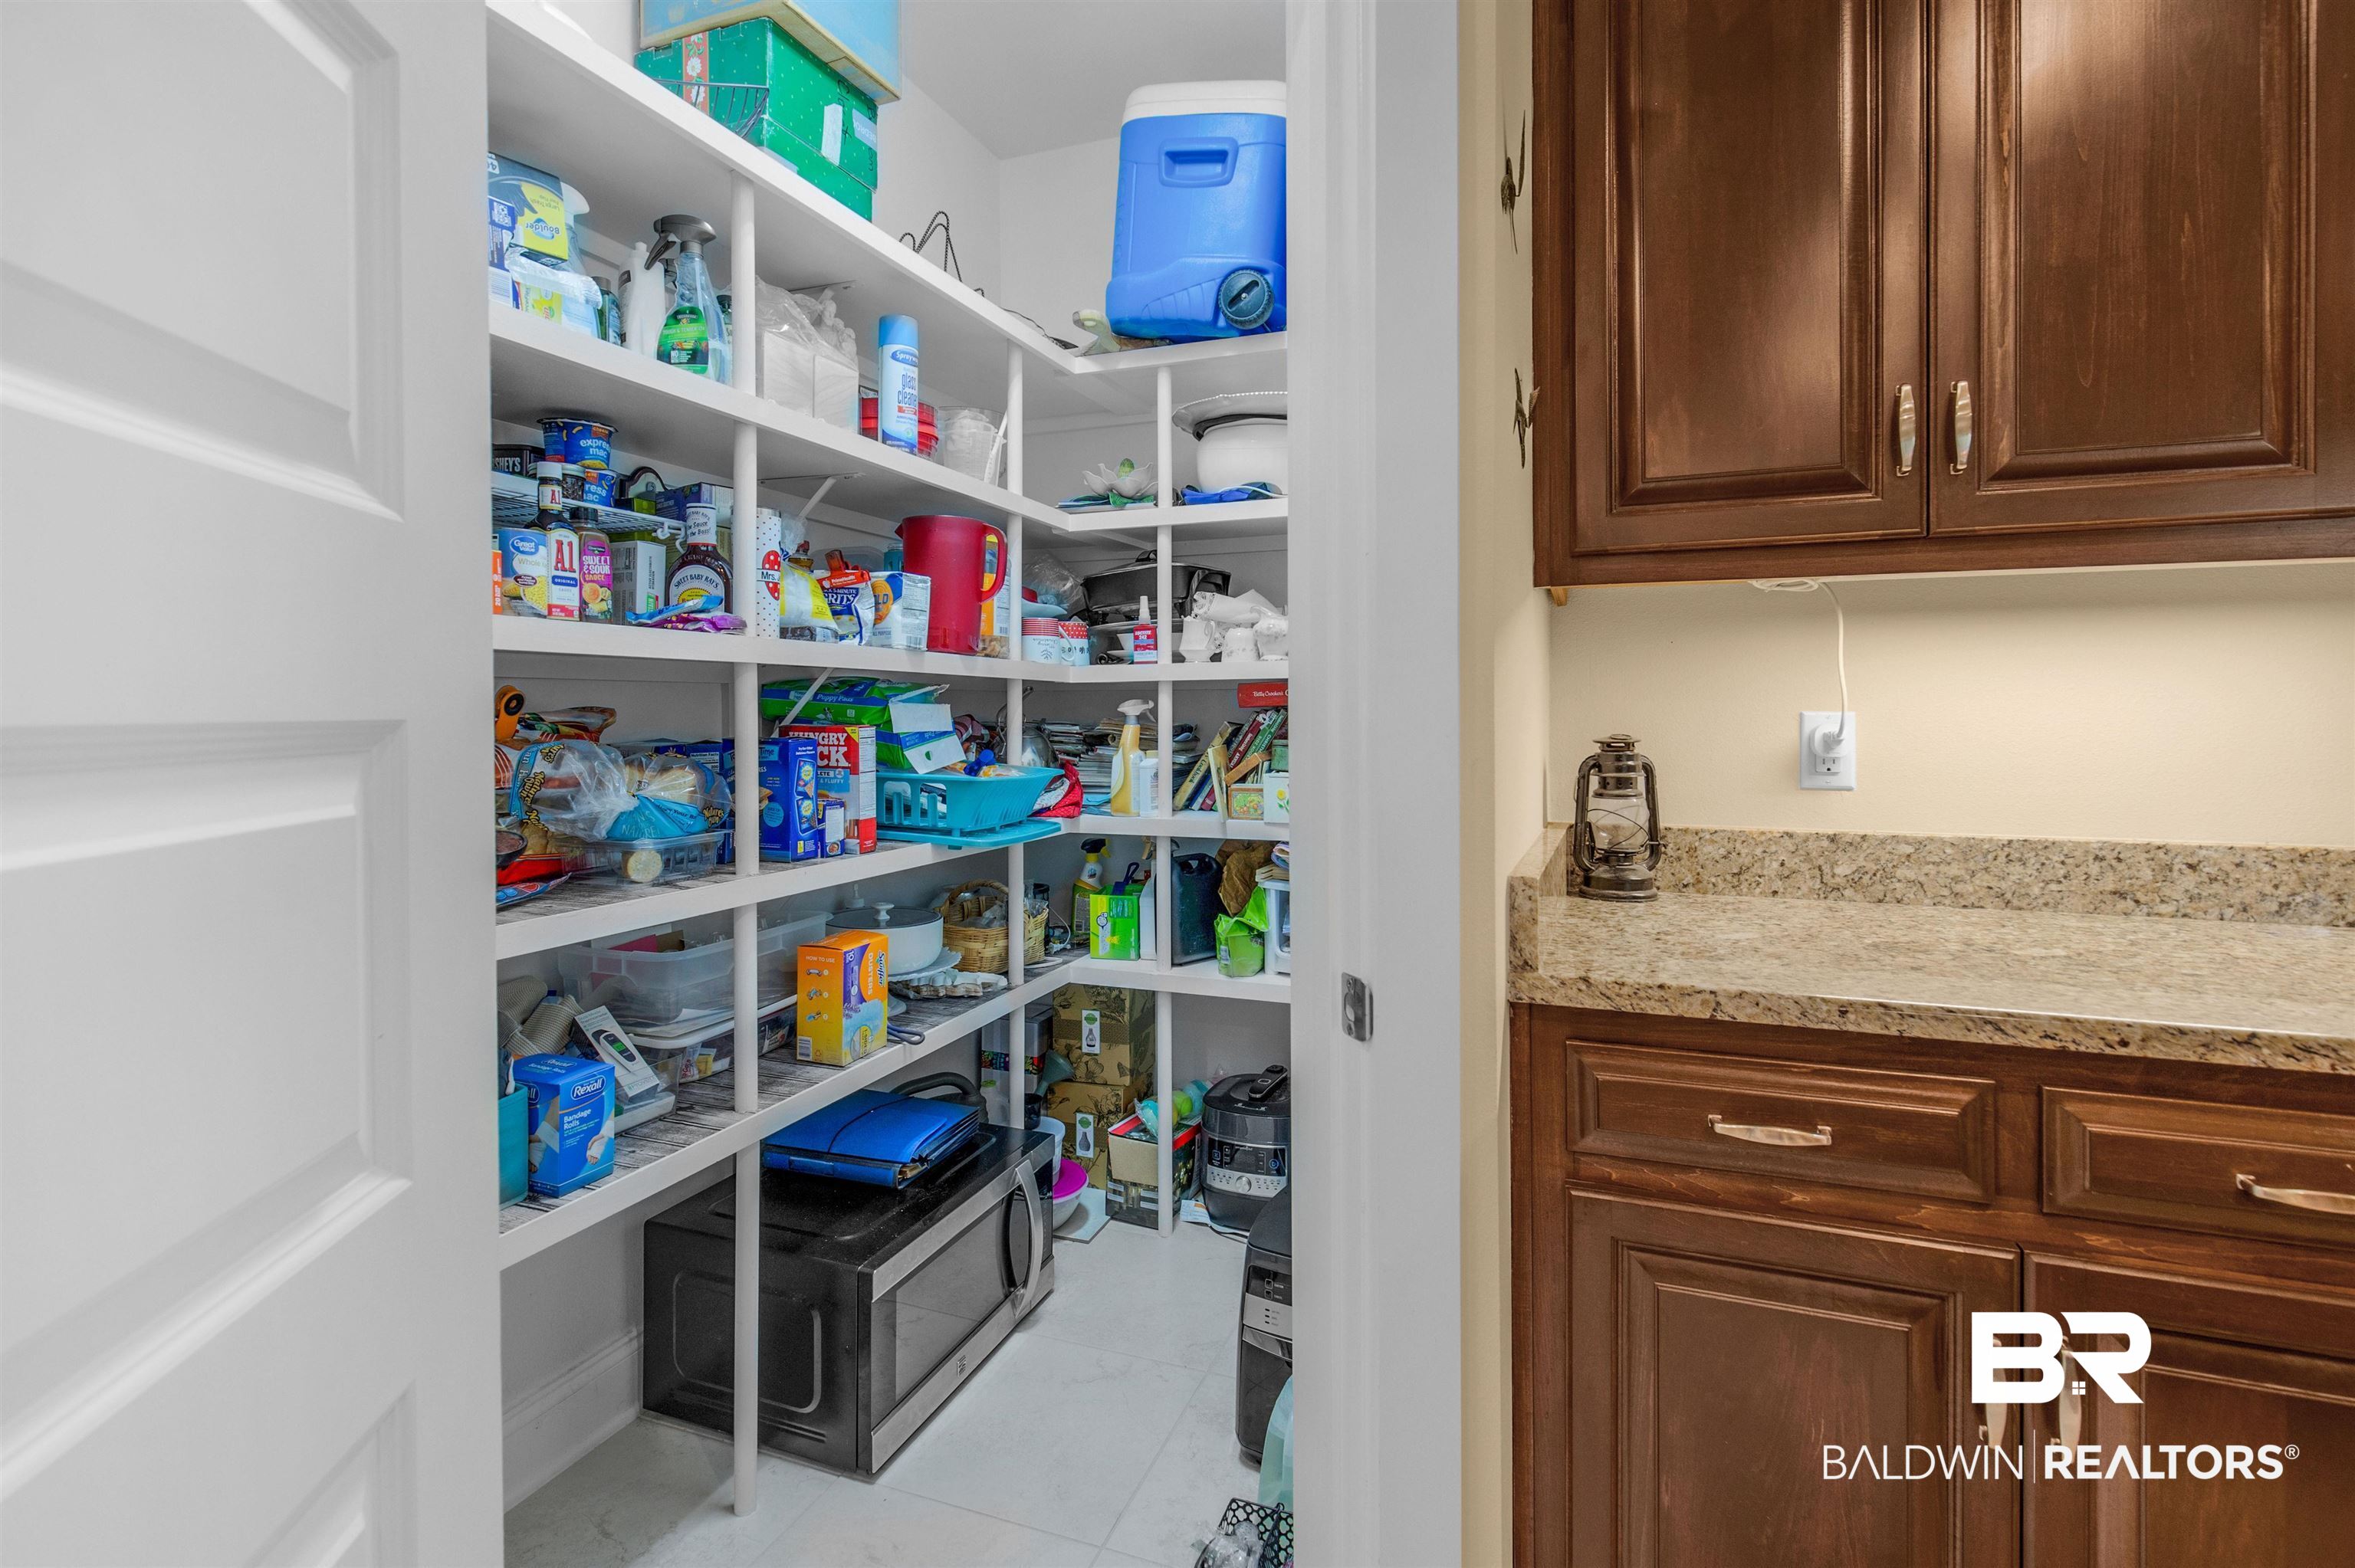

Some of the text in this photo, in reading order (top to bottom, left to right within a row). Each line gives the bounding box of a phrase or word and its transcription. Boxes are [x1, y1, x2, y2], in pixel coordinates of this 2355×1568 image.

[525, 222, 560, 235] Boulder
[902, 372, 916, 391] glass
[590, 448, 608, 458] mac
[514, 539, 535, 548] Great
[553, 539, 576, 573] A1
[583, 556, 610, 566] SWEET
[517, 557, 537, 566] Whole
[590, 565, 611, 575] SOUR
[761, 571, 777, 581] Mrs.
[674, 576, 689, 589] SWEET
[816, 694, 836, 704] Puppy
[848, 950, 855, 961] 10
[573, 1078, 603, 1097] Rexall
[563, 1108, 592, 1123] Bandage
[563, 1120, 580, 1130] Rolls
